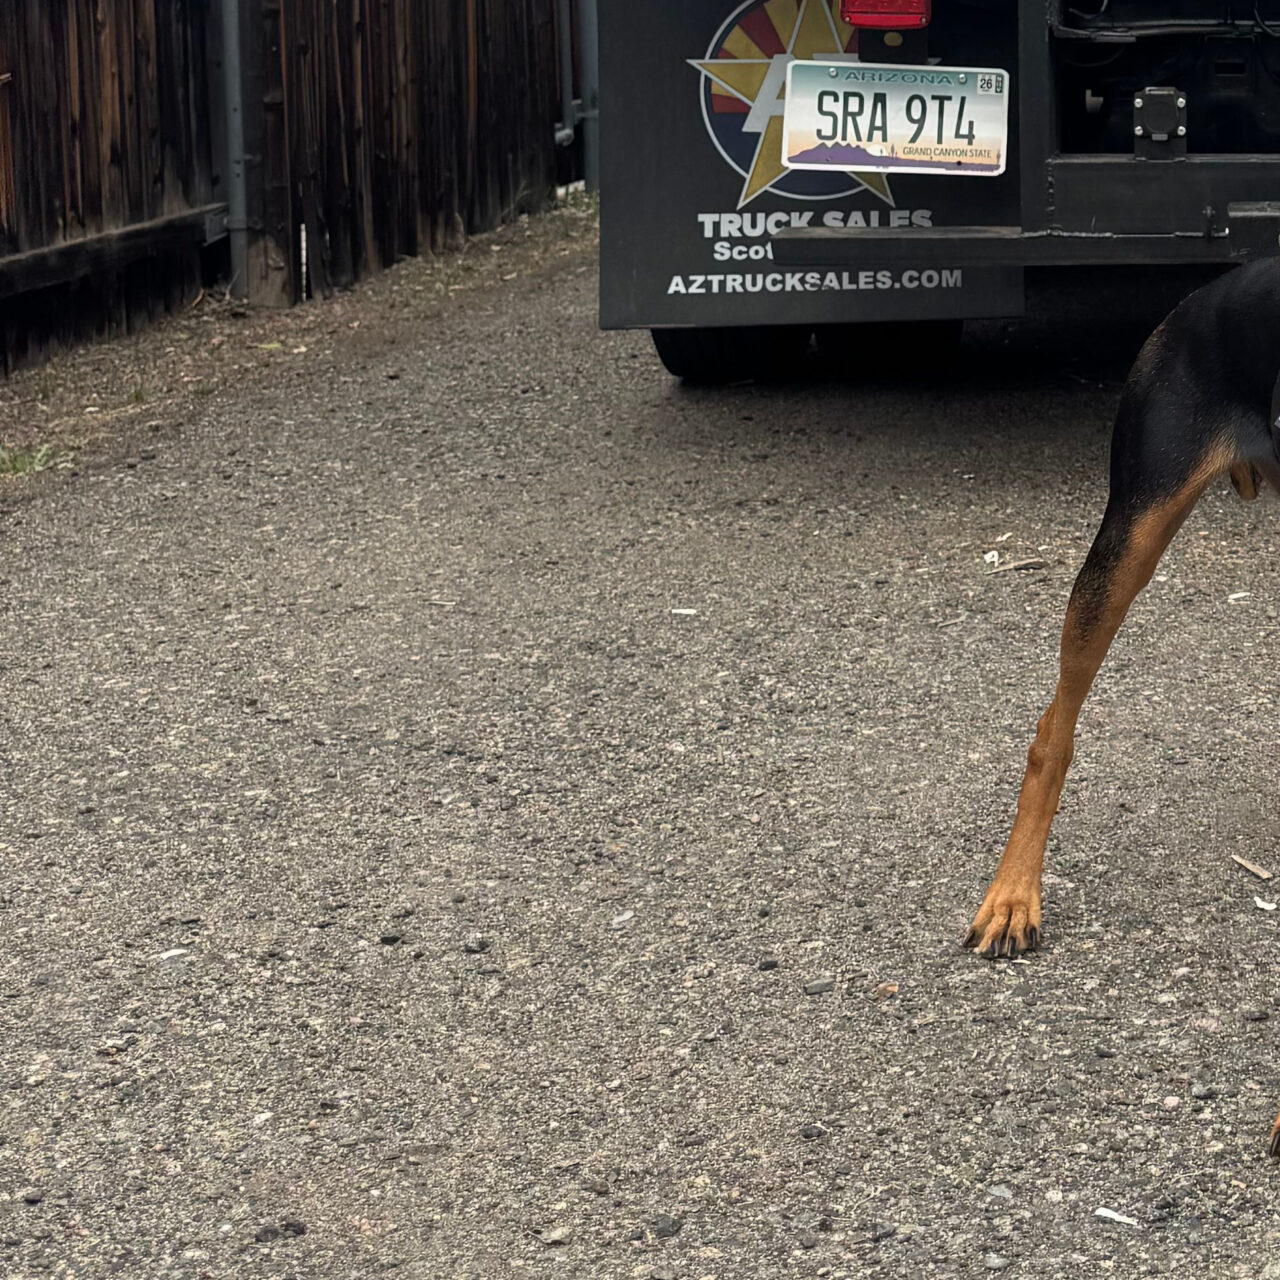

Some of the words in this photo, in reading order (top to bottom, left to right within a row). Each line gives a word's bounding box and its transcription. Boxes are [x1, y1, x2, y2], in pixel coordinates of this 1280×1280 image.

[844, 70, 953, 86] ARIZONA
[980, 78, 993, 90] 26
[816, 90, 889, 143] SRA
[904, 94, 976, 146] 9T4
[902, 146, 932, 156] GRAND
[933, 147, 967, 158] CANYON
[969, 149, 992, 159] STATE
[698, 212, 814, 238] TRUCK
[667, 269, 963, 295] AZTRUCKSALES.COM
